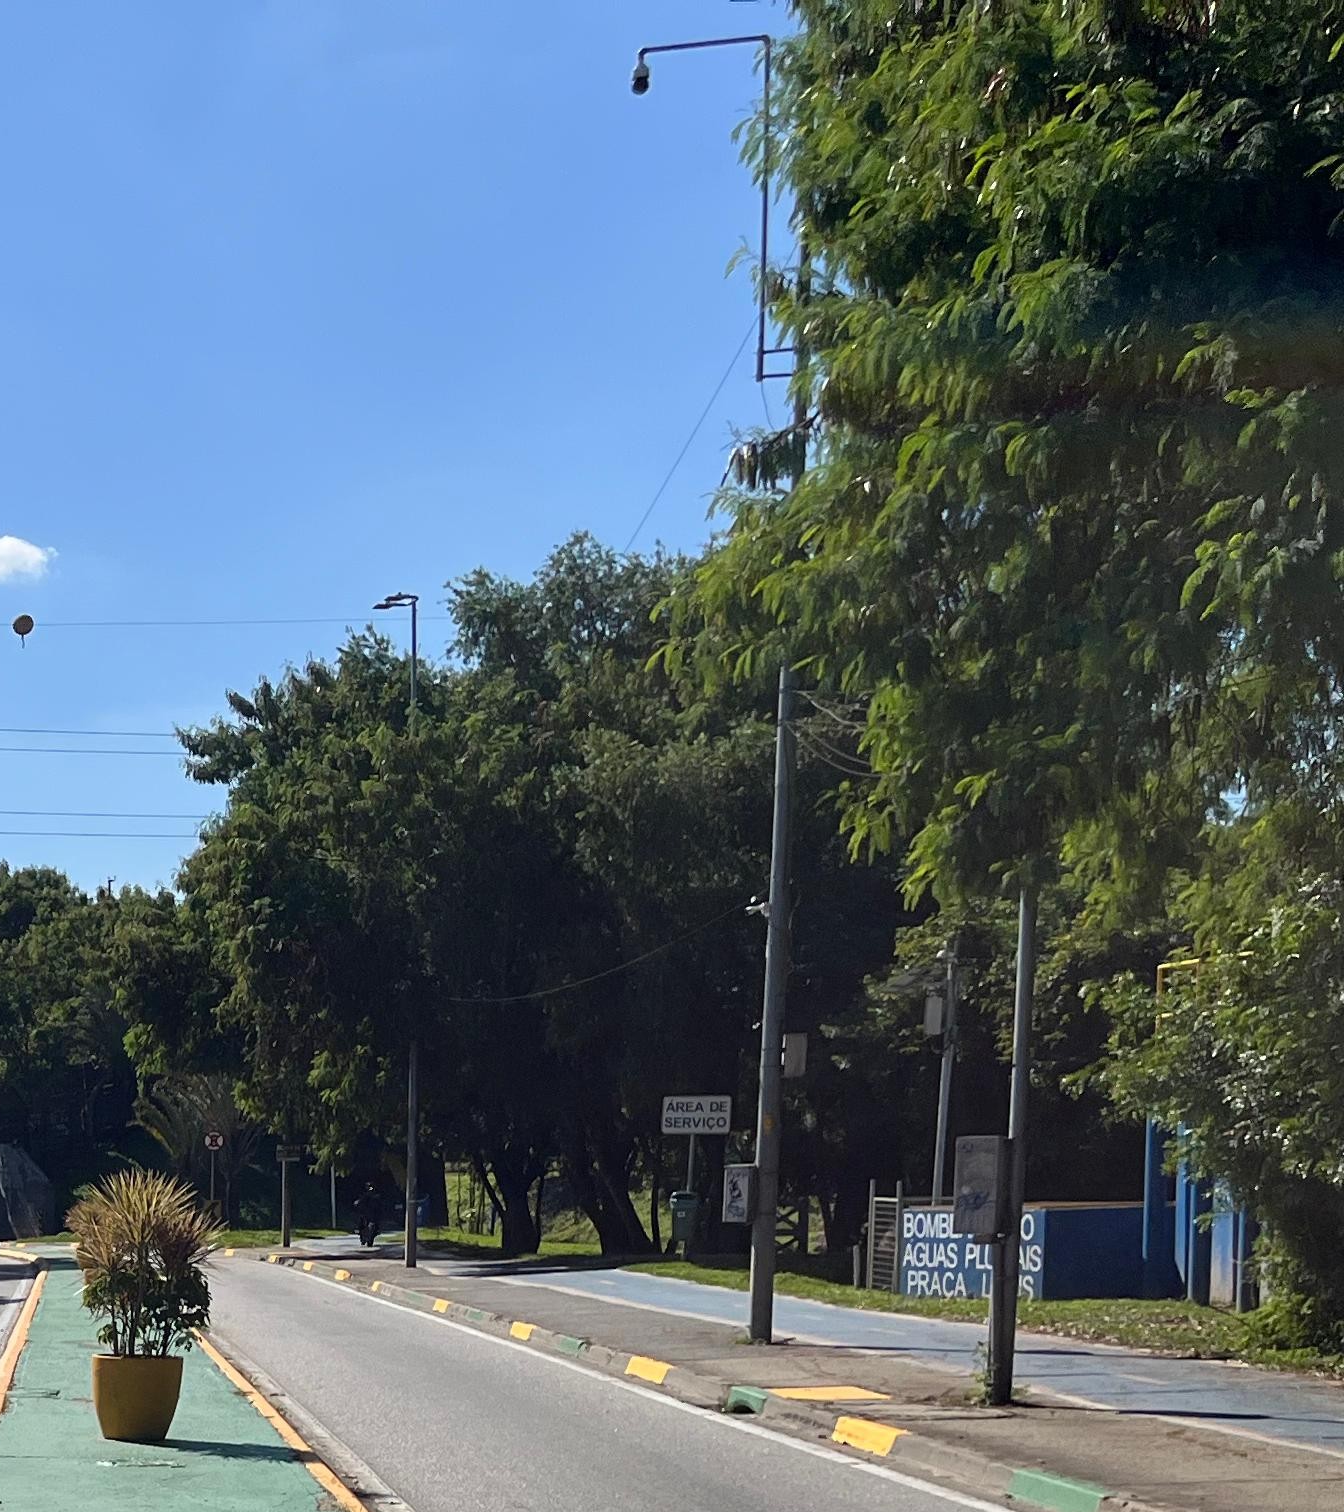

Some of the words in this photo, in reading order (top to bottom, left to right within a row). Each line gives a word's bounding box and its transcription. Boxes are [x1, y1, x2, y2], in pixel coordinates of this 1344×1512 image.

[665, 1100, 705, 1113] ÁREA
[709, 1101, 728, 1113] DE
[664, 1116, 728, 1130] SERVIÇO
[903, 1239, 959, 1269] ÁGUAS
[907, 1270, 967, 1301] PRAÇA
